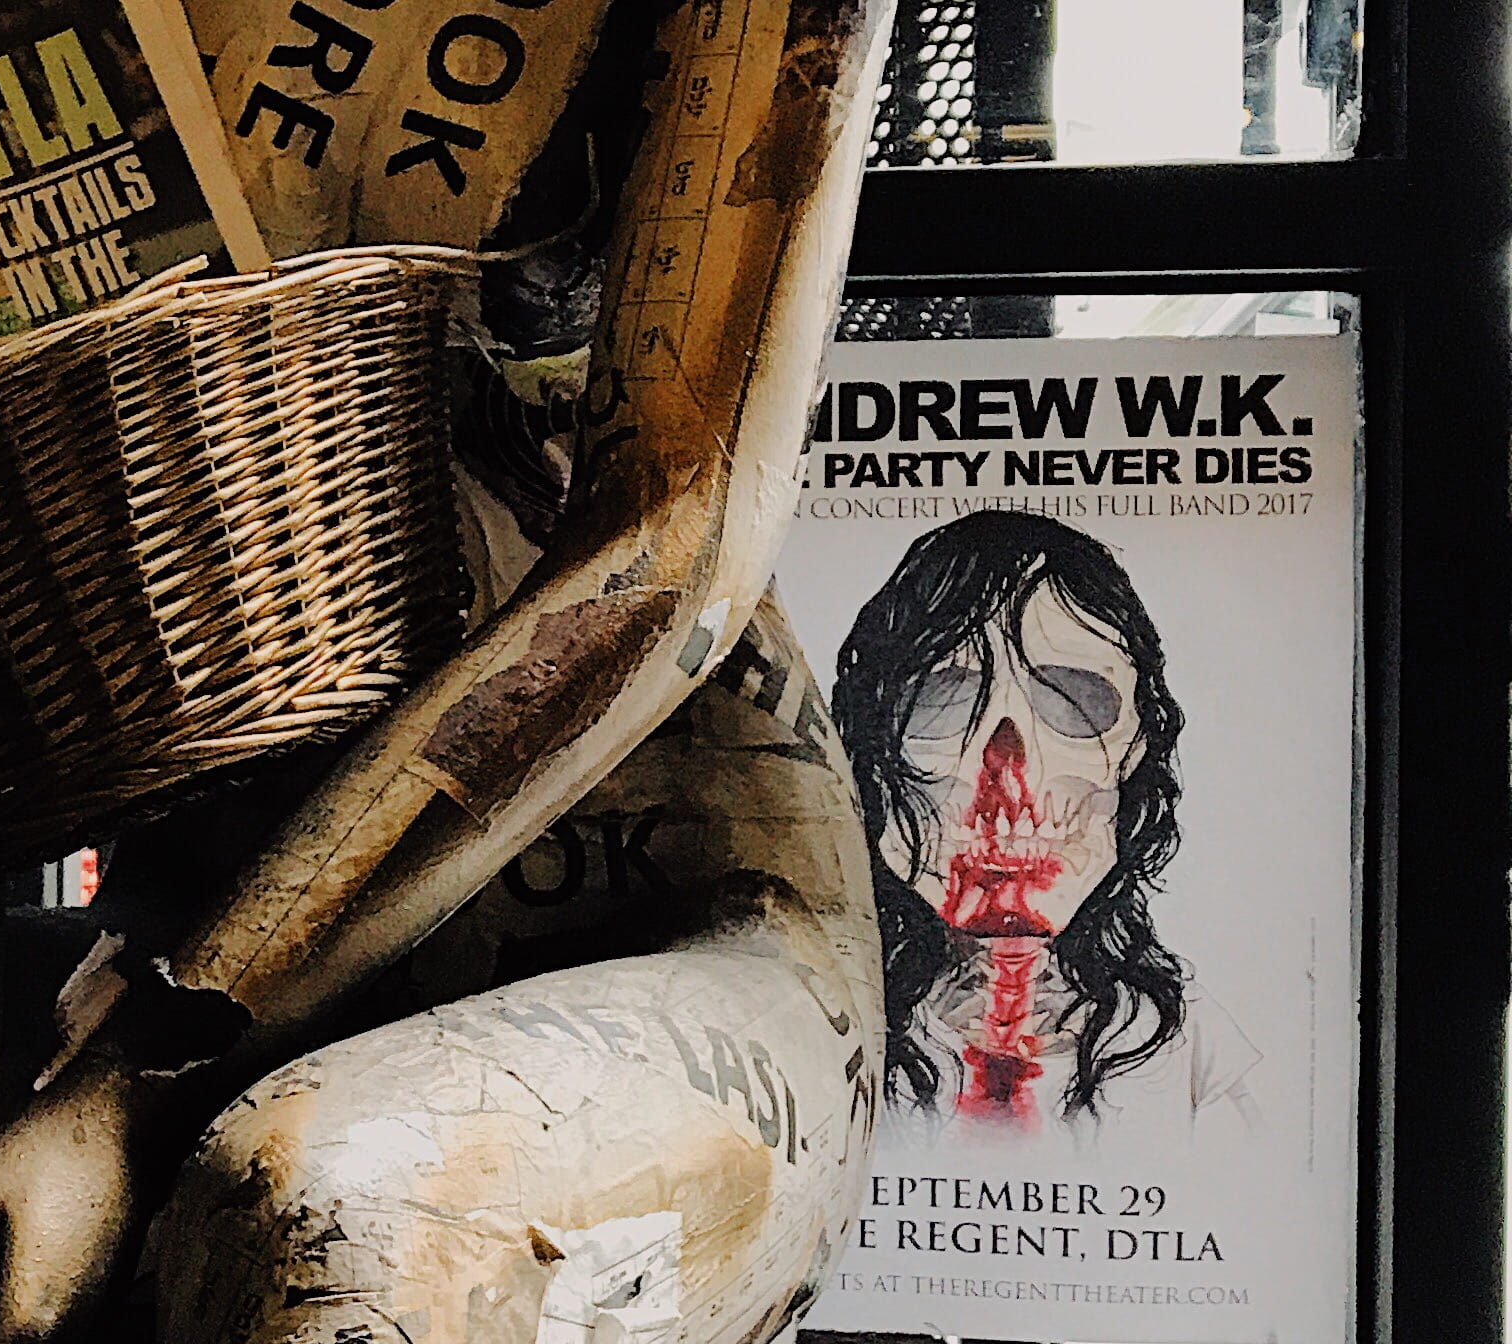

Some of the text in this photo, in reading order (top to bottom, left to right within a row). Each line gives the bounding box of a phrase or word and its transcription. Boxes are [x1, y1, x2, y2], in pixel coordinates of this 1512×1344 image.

[5, 229, 143, 318] IN THE
[1115, 373, 1315, 439] W.K.
[825, 446, 1312, 488] PARTY NEVER DIES
[810, 496, 945, 520] CONCERT
[953, 494, 1042, 518] WITH
[1097, 494, 1163, 517] FULL
[1171, 493, 1249, 516] BAND
[1257, 492, 1314, 516] 2017
[871, 1174, 1168, 1217] EPTEMBER 29
[897, 1219, 1086, 1261] REGENT,
[1107, 1228, 1226, 1262] DTLA
[872, 1273, 900, 1293] AT
[911, 1274, 1250, 1306] THEREGENTTHEATER.COM
